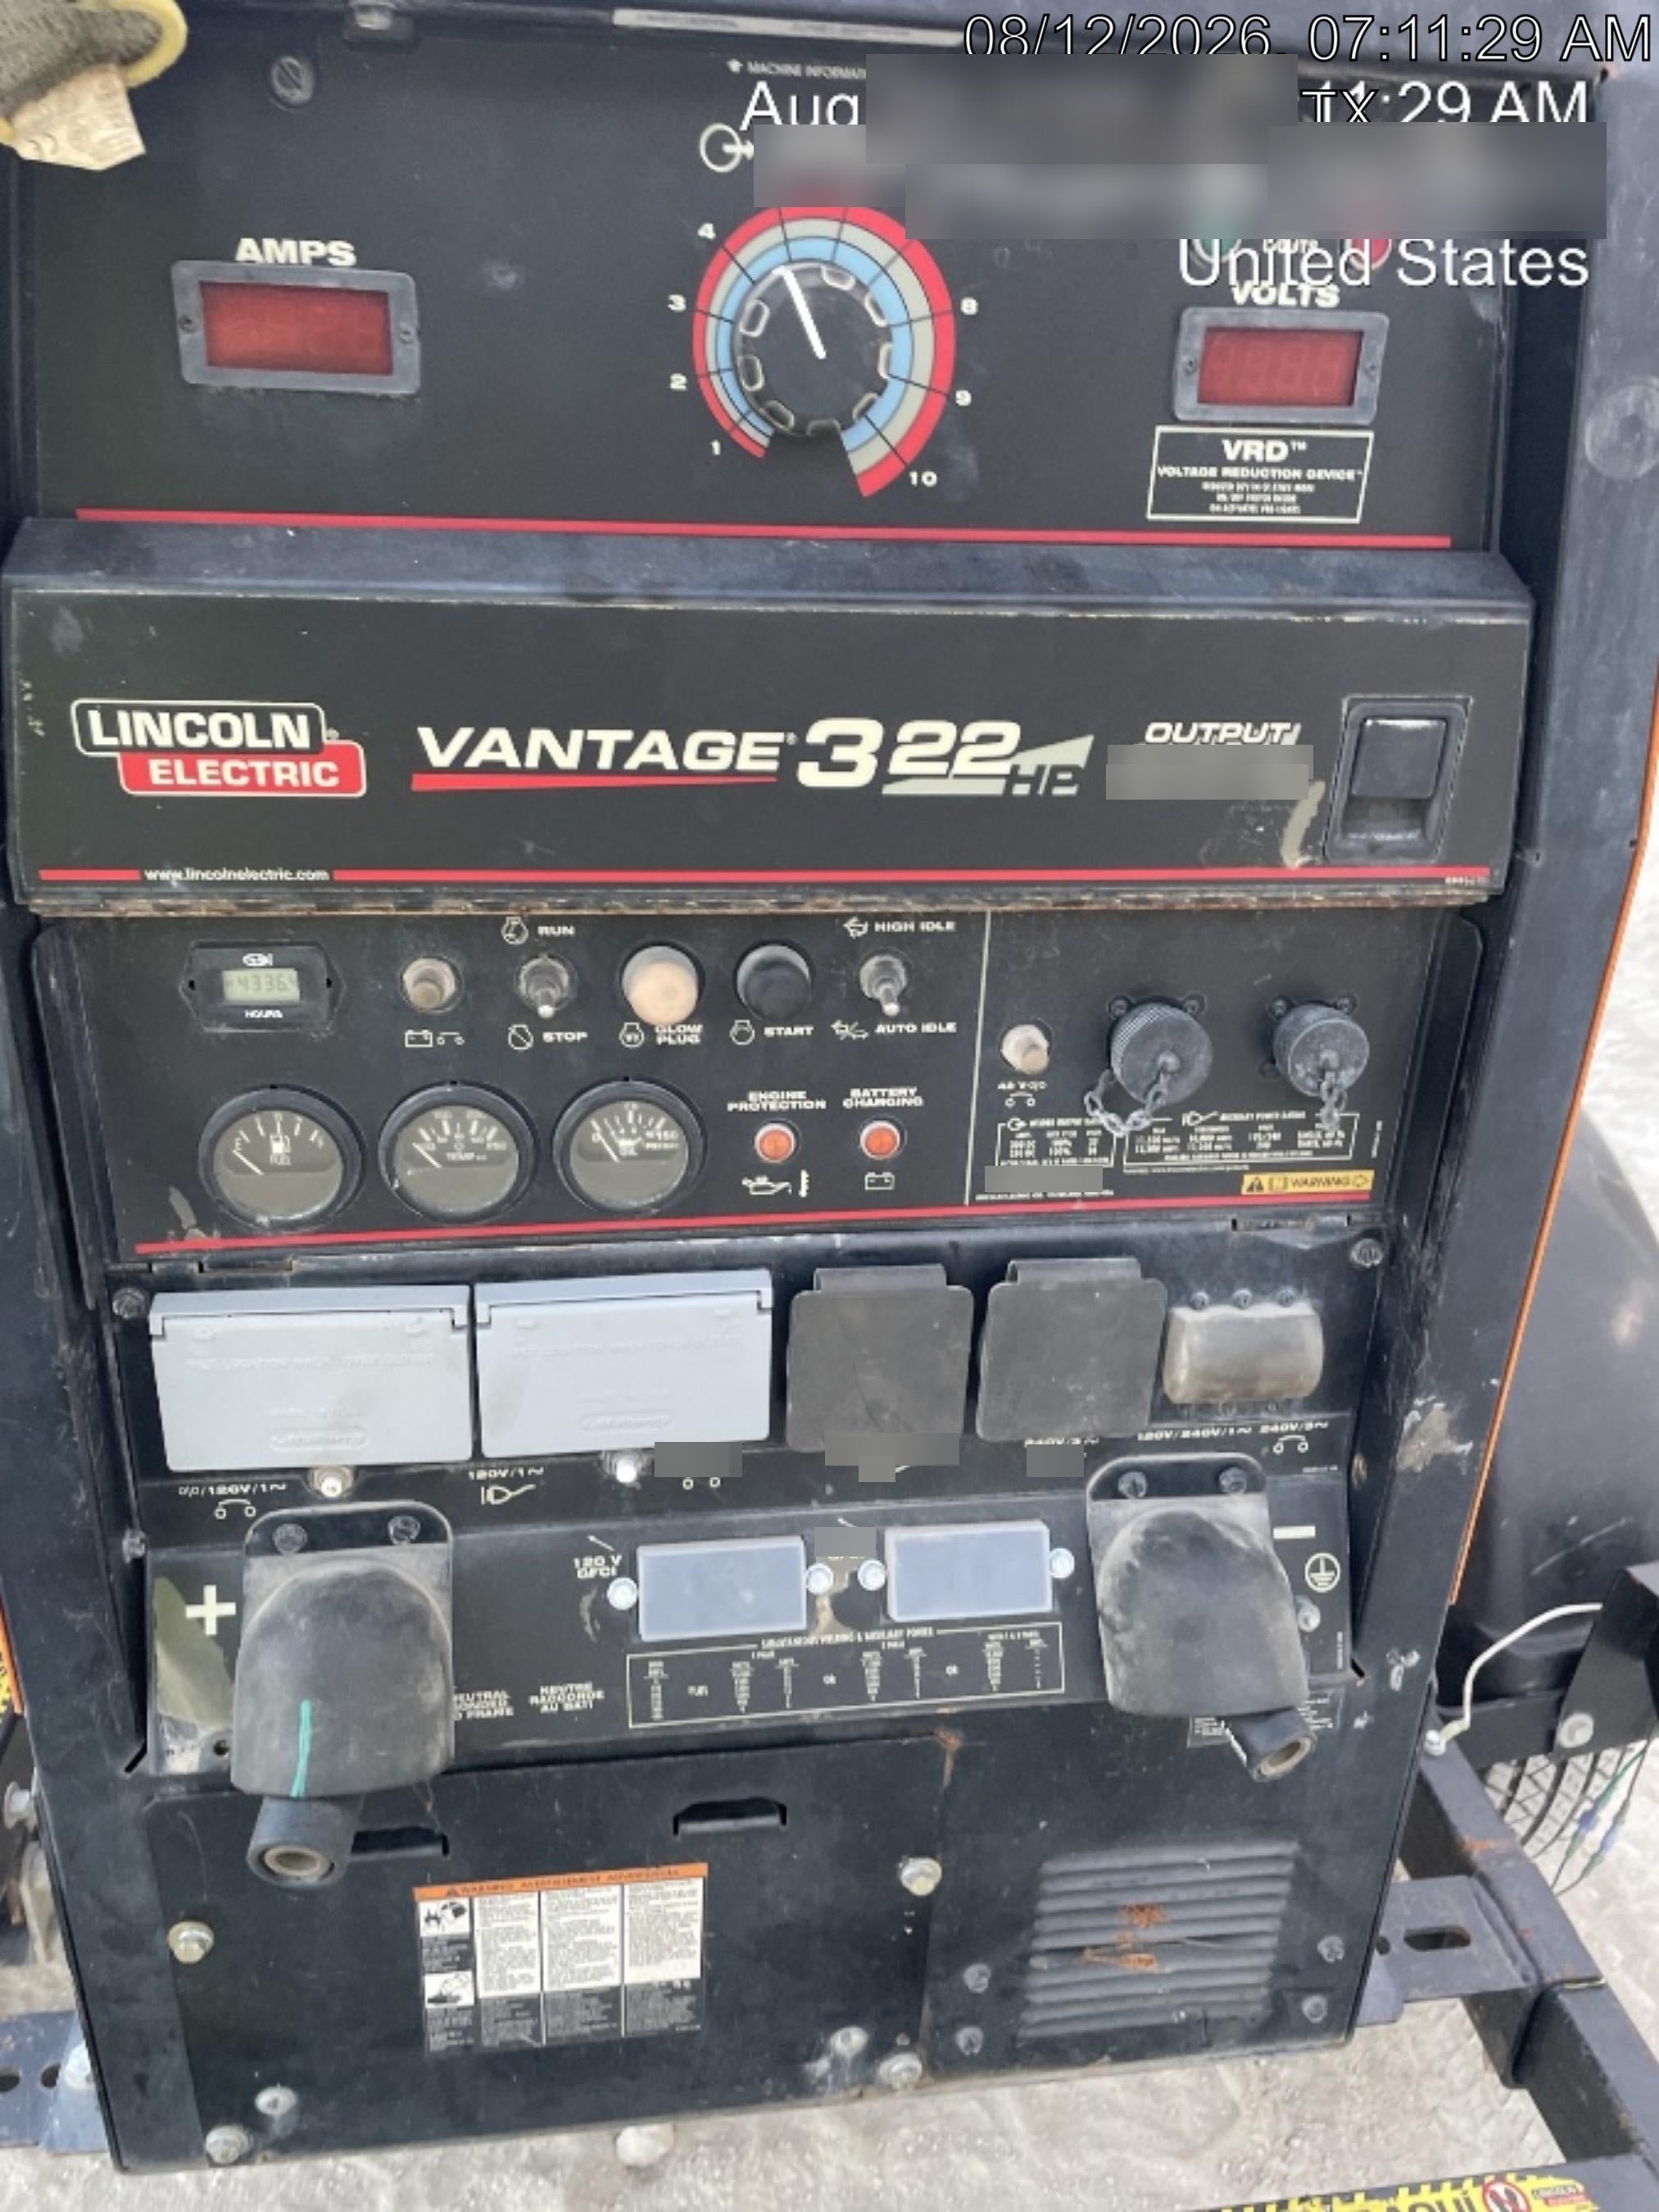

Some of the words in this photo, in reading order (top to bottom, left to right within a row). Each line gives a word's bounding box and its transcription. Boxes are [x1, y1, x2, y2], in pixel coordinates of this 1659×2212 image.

[697, 223, 716, 240] 4
[234, 238, 357, 266] AMPS
[1231, 279, 1340, 308] VOLTS
[668, 294, 687, 312] 3
[669, 374, 688, 391] 2
[955, 390, 972, 406] 9
[710, 440, 721, 456] 1
[909, 471, 938, 487] 10
[1157, 465, 1218, 478] VOLTAGE
[1222, 467, 1303, 480] REDUCTION
[87, 709, 310, 750] LINCOLN
[1145, 722, 1293, 744] OUTPUT
[796, 717, 1022, 789] 322
[147, 758, 340, 787] ELECTRIC
[144, 867, 330, 882] www.lincolnelectric.com
[537, 925, 575, 936] RUN
[874, 921, 915, 932] HIGH
[919, 921, 956, 931] IDLE
[655, 1024, 703, 1035] GLOW
[764, 1025, 814, 1037] START
[874, 1023, 917, 1034] AUTO
[920, 1022, 957, 1033] IDLE
[542, 1031, 588, 1043] STOP
[657, 1033, 701, 1045] PLUG
[747, 1090, 808, 1102] ENGINE
[850, 1086, 918, 1099] BATTERY
[727, 1099, 827, 1112] PROTECTION
[842, 1096, 924, 1109] CHARGING
[1291, 1176, 1350, 1188] WARNING
